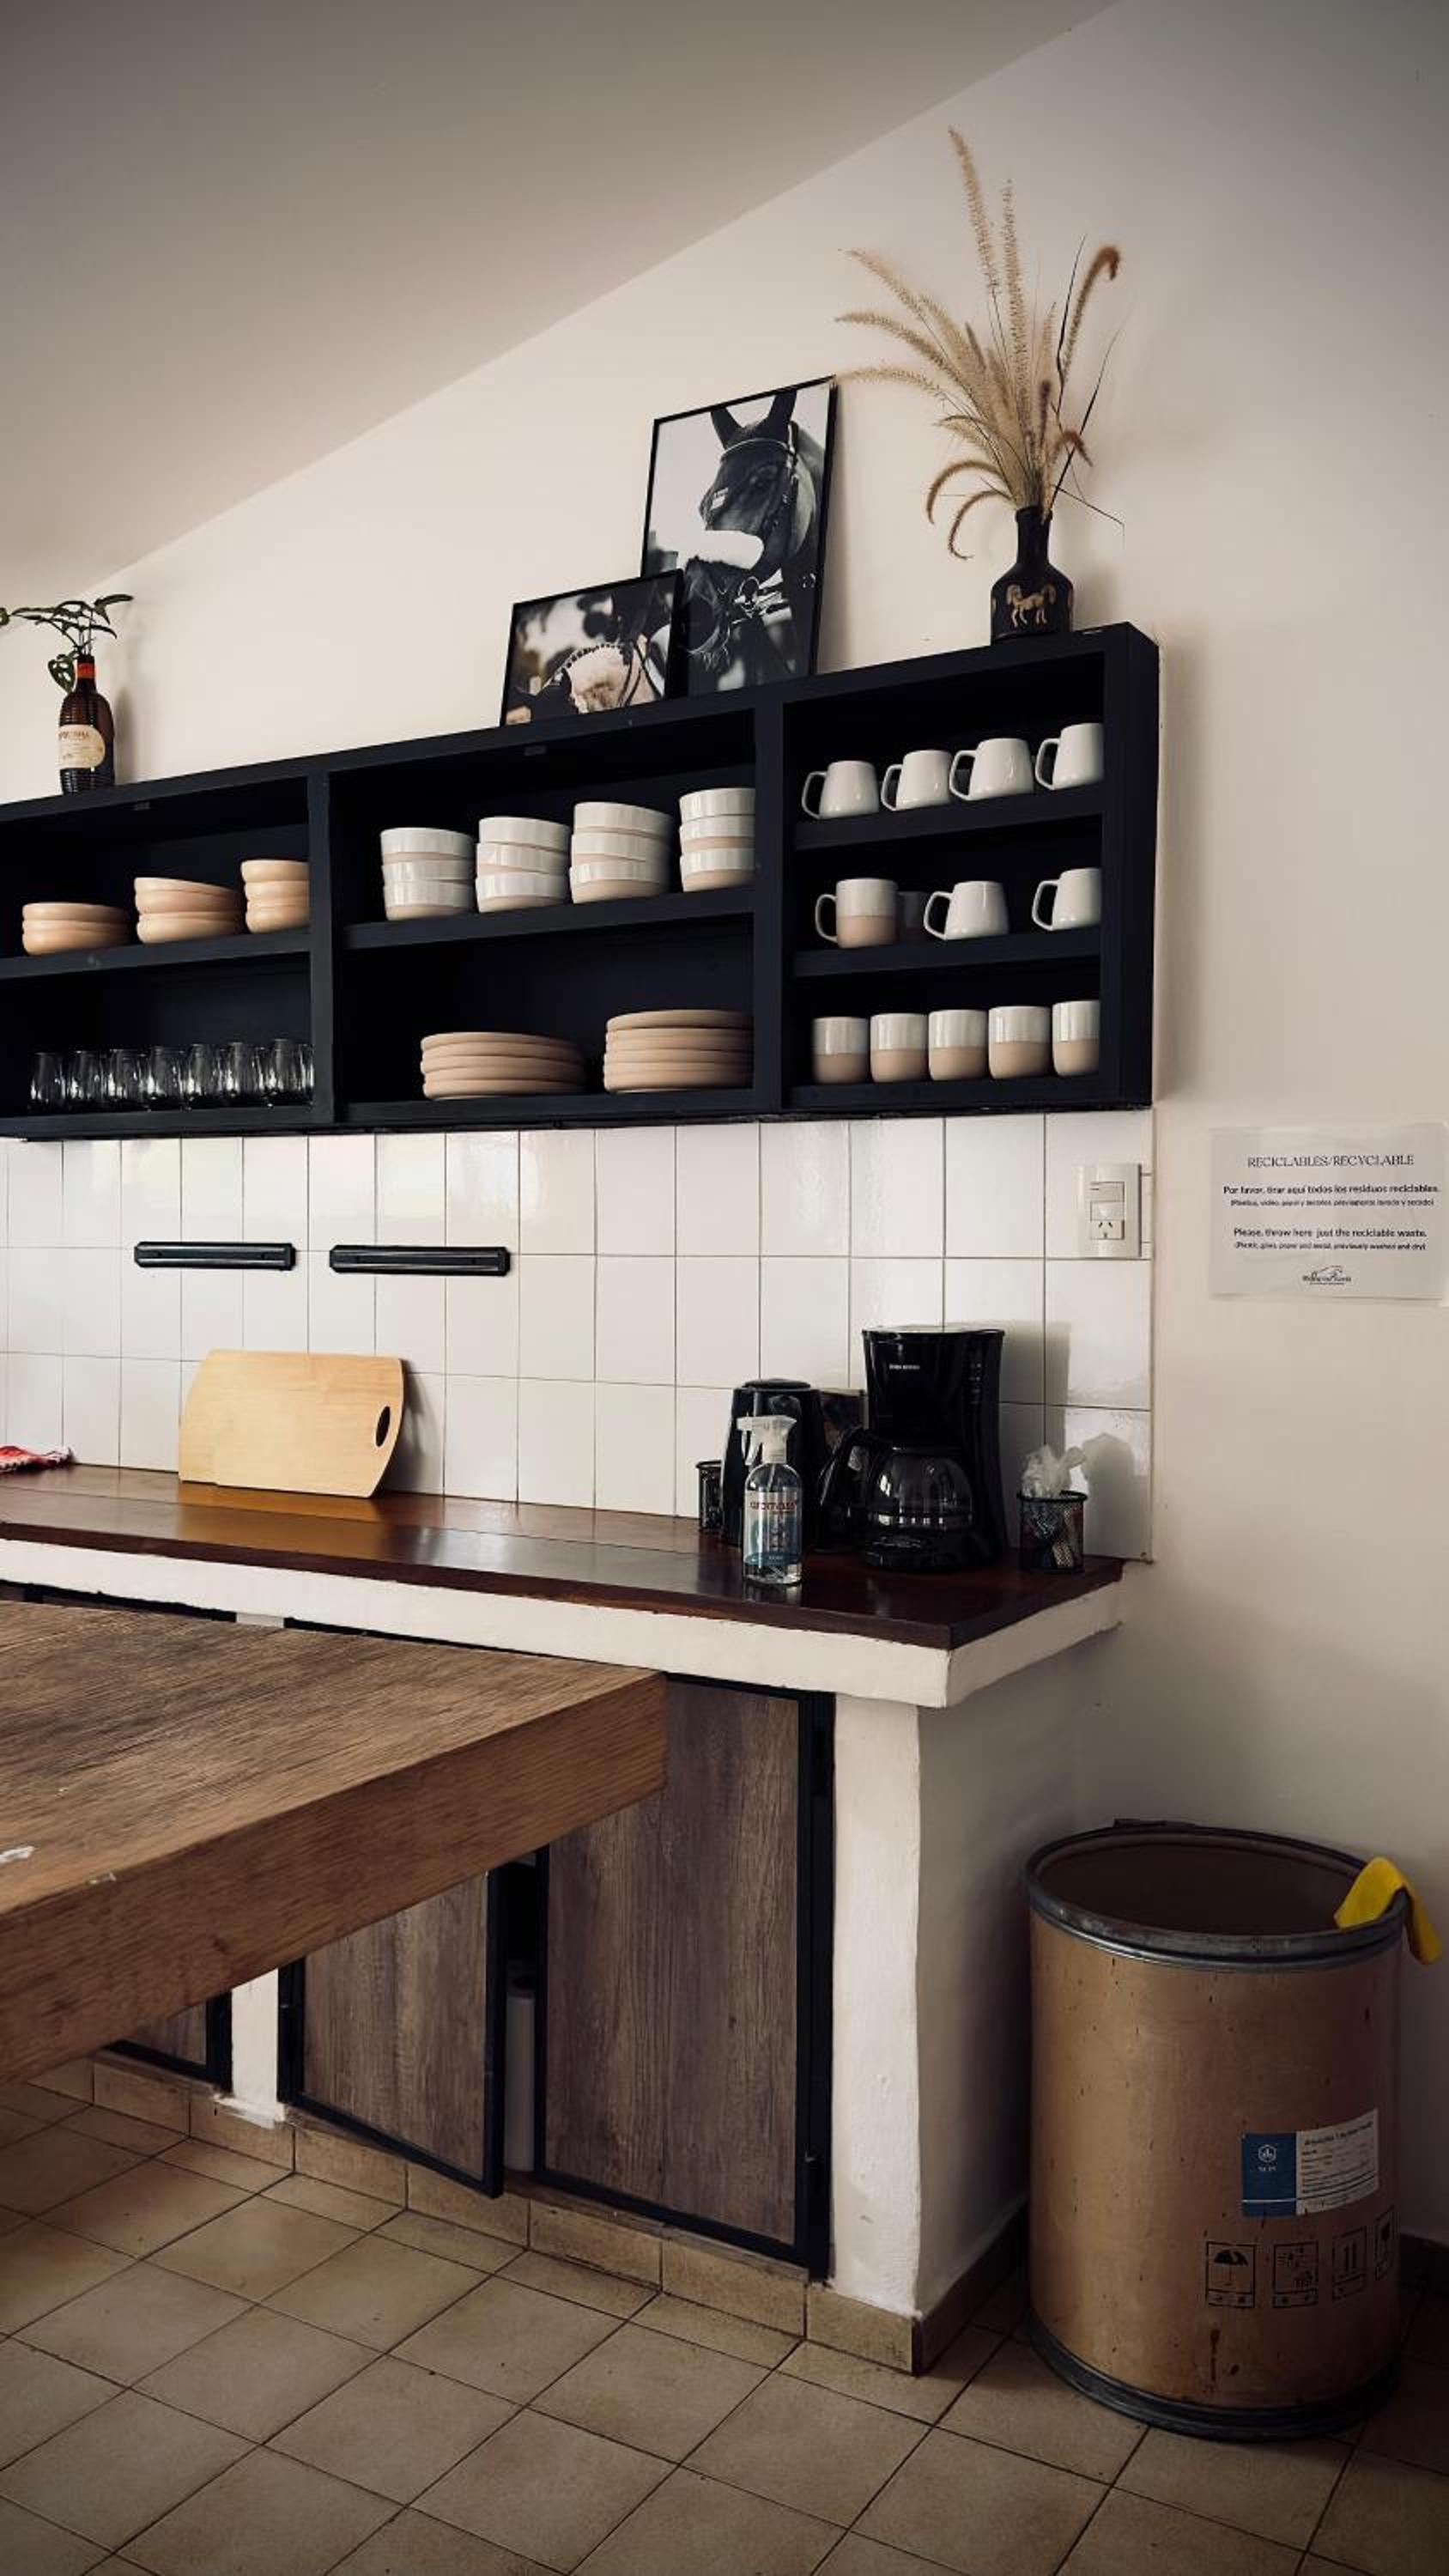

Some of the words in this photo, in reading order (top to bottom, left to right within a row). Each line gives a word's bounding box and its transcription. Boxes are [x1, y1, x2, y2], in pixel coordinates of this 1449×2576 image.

[1307, 1185, 1333, 1194] todos
[1316, 1228, 1333, 1238] just
[1336, 1228, 1350, 1236] the
